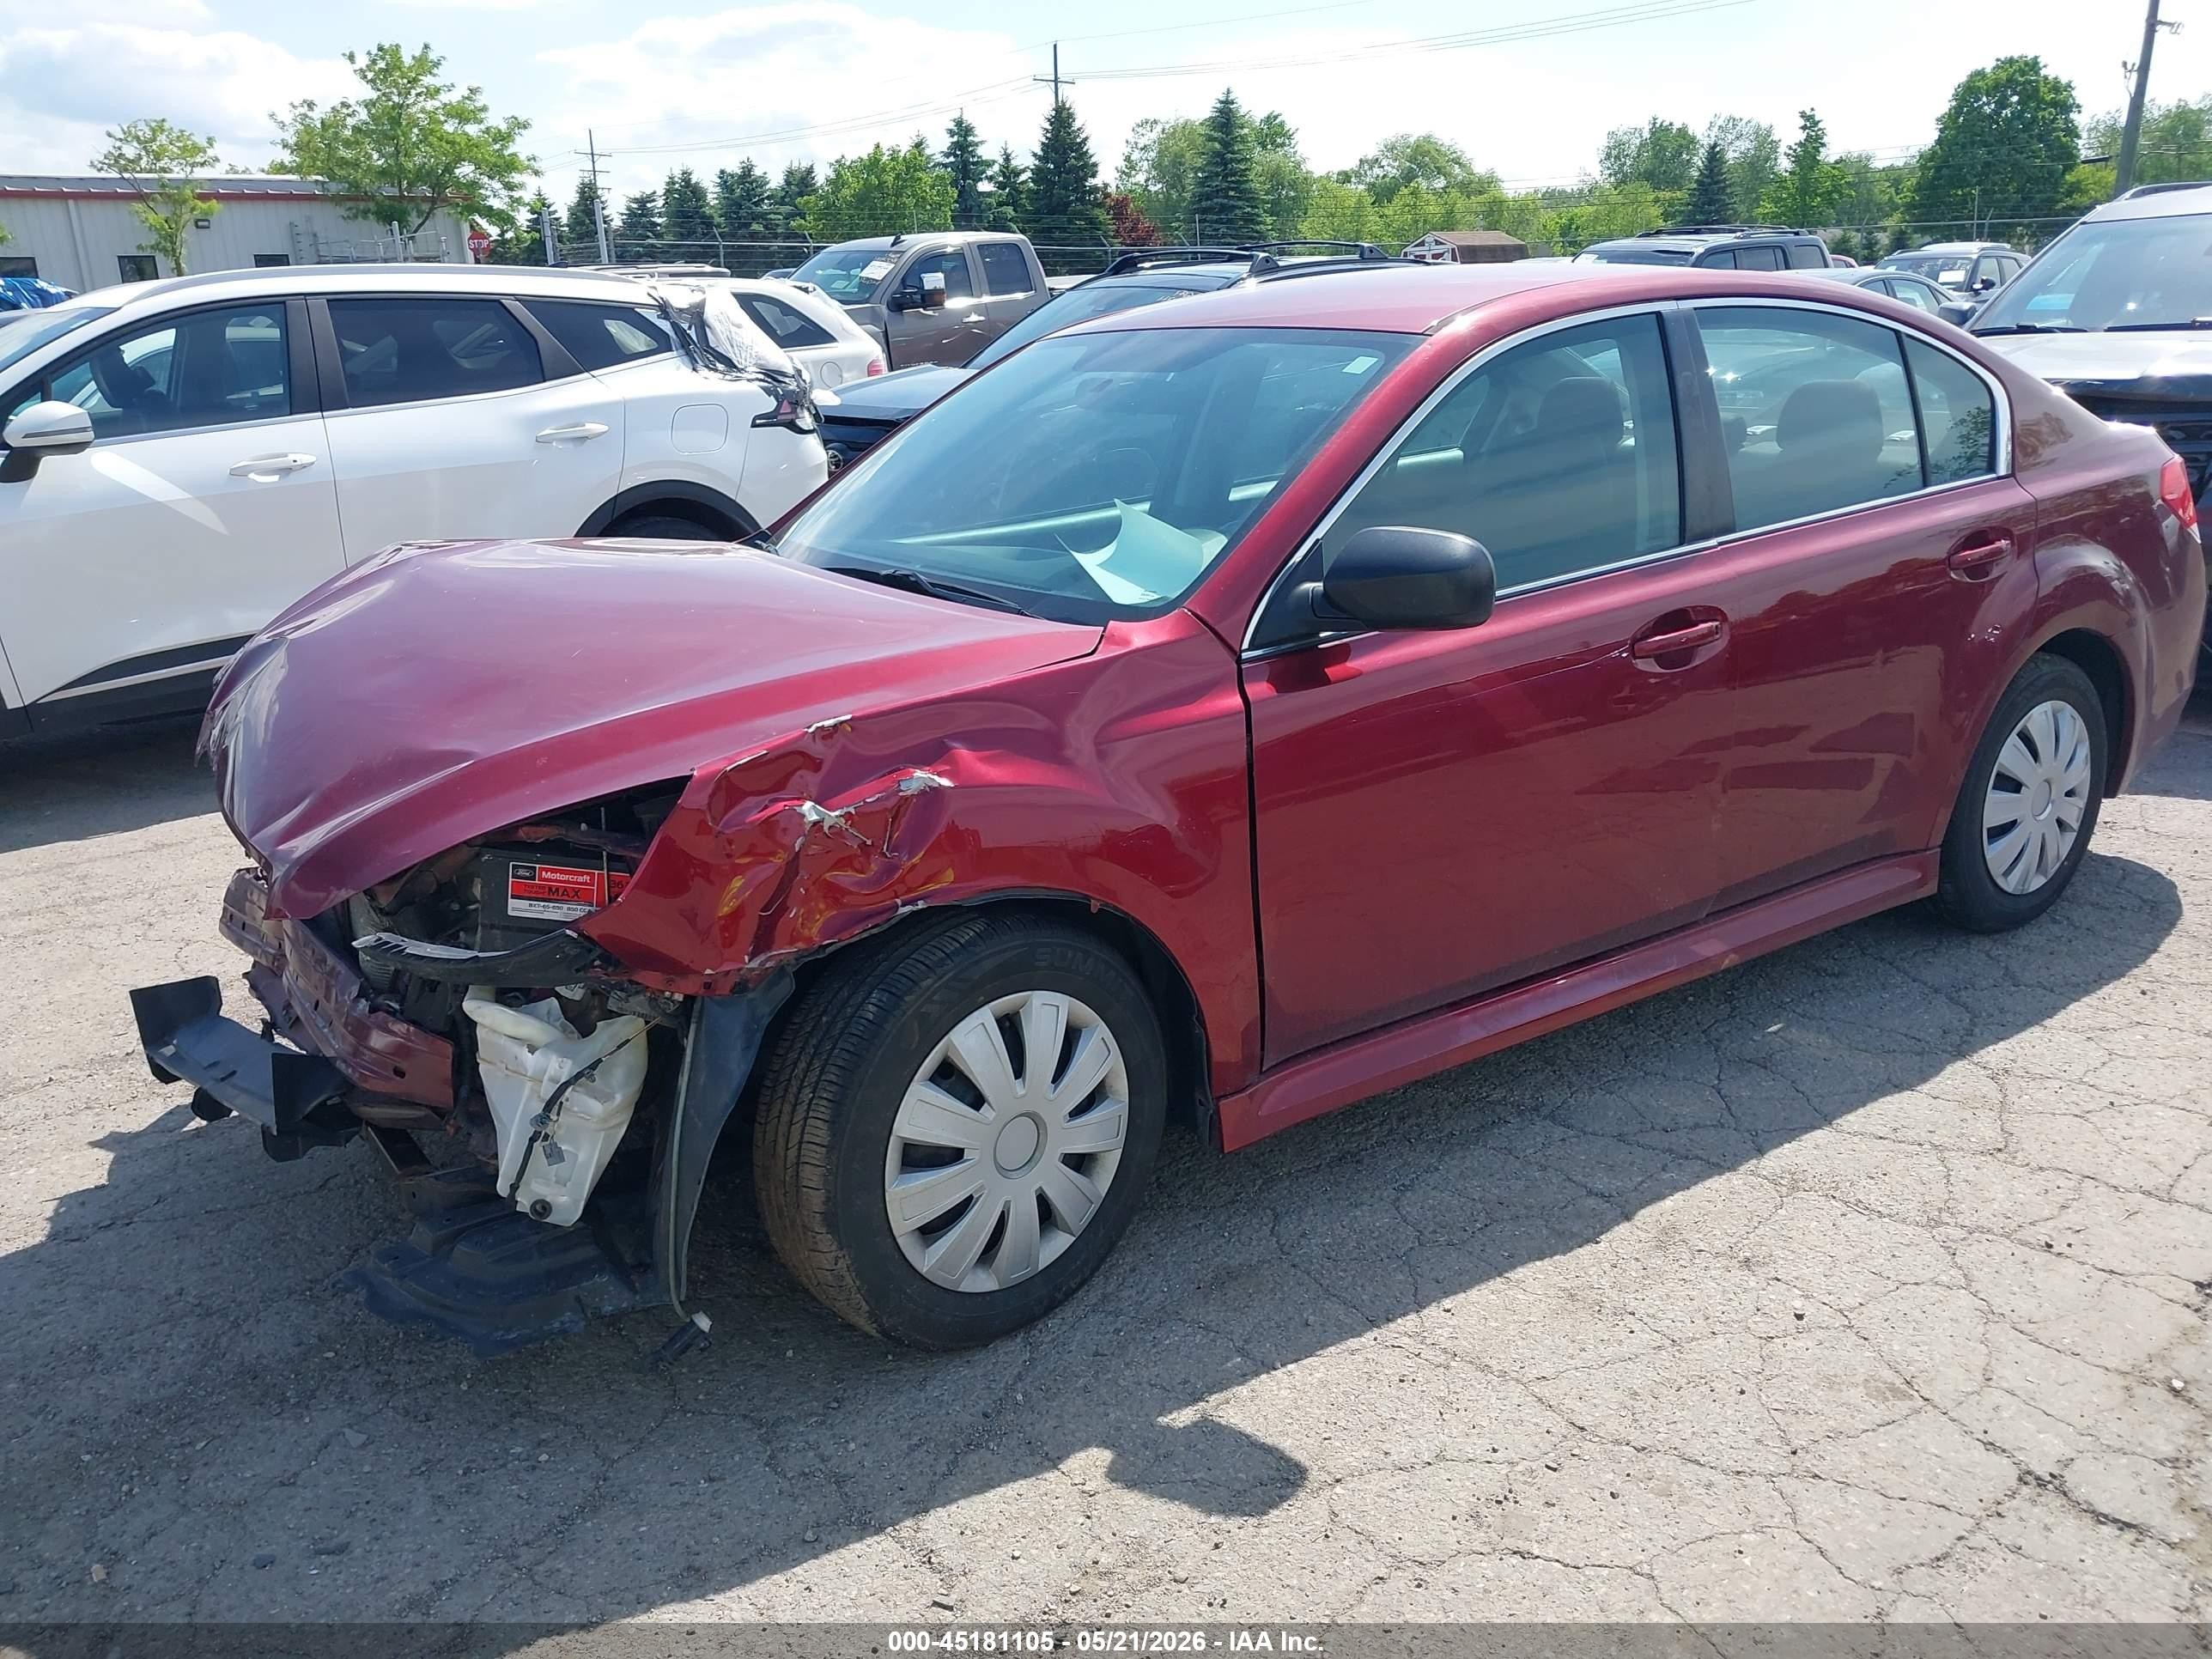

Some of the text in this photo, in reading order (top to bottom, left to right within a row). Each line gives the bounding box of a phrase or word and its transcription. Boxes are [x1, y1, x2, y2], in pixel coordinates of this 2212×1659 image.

[469, 239, 489, 248] STOP
[542, 871, 591, 884] Motorcraft
[548, 886, 580, 899] MAX
